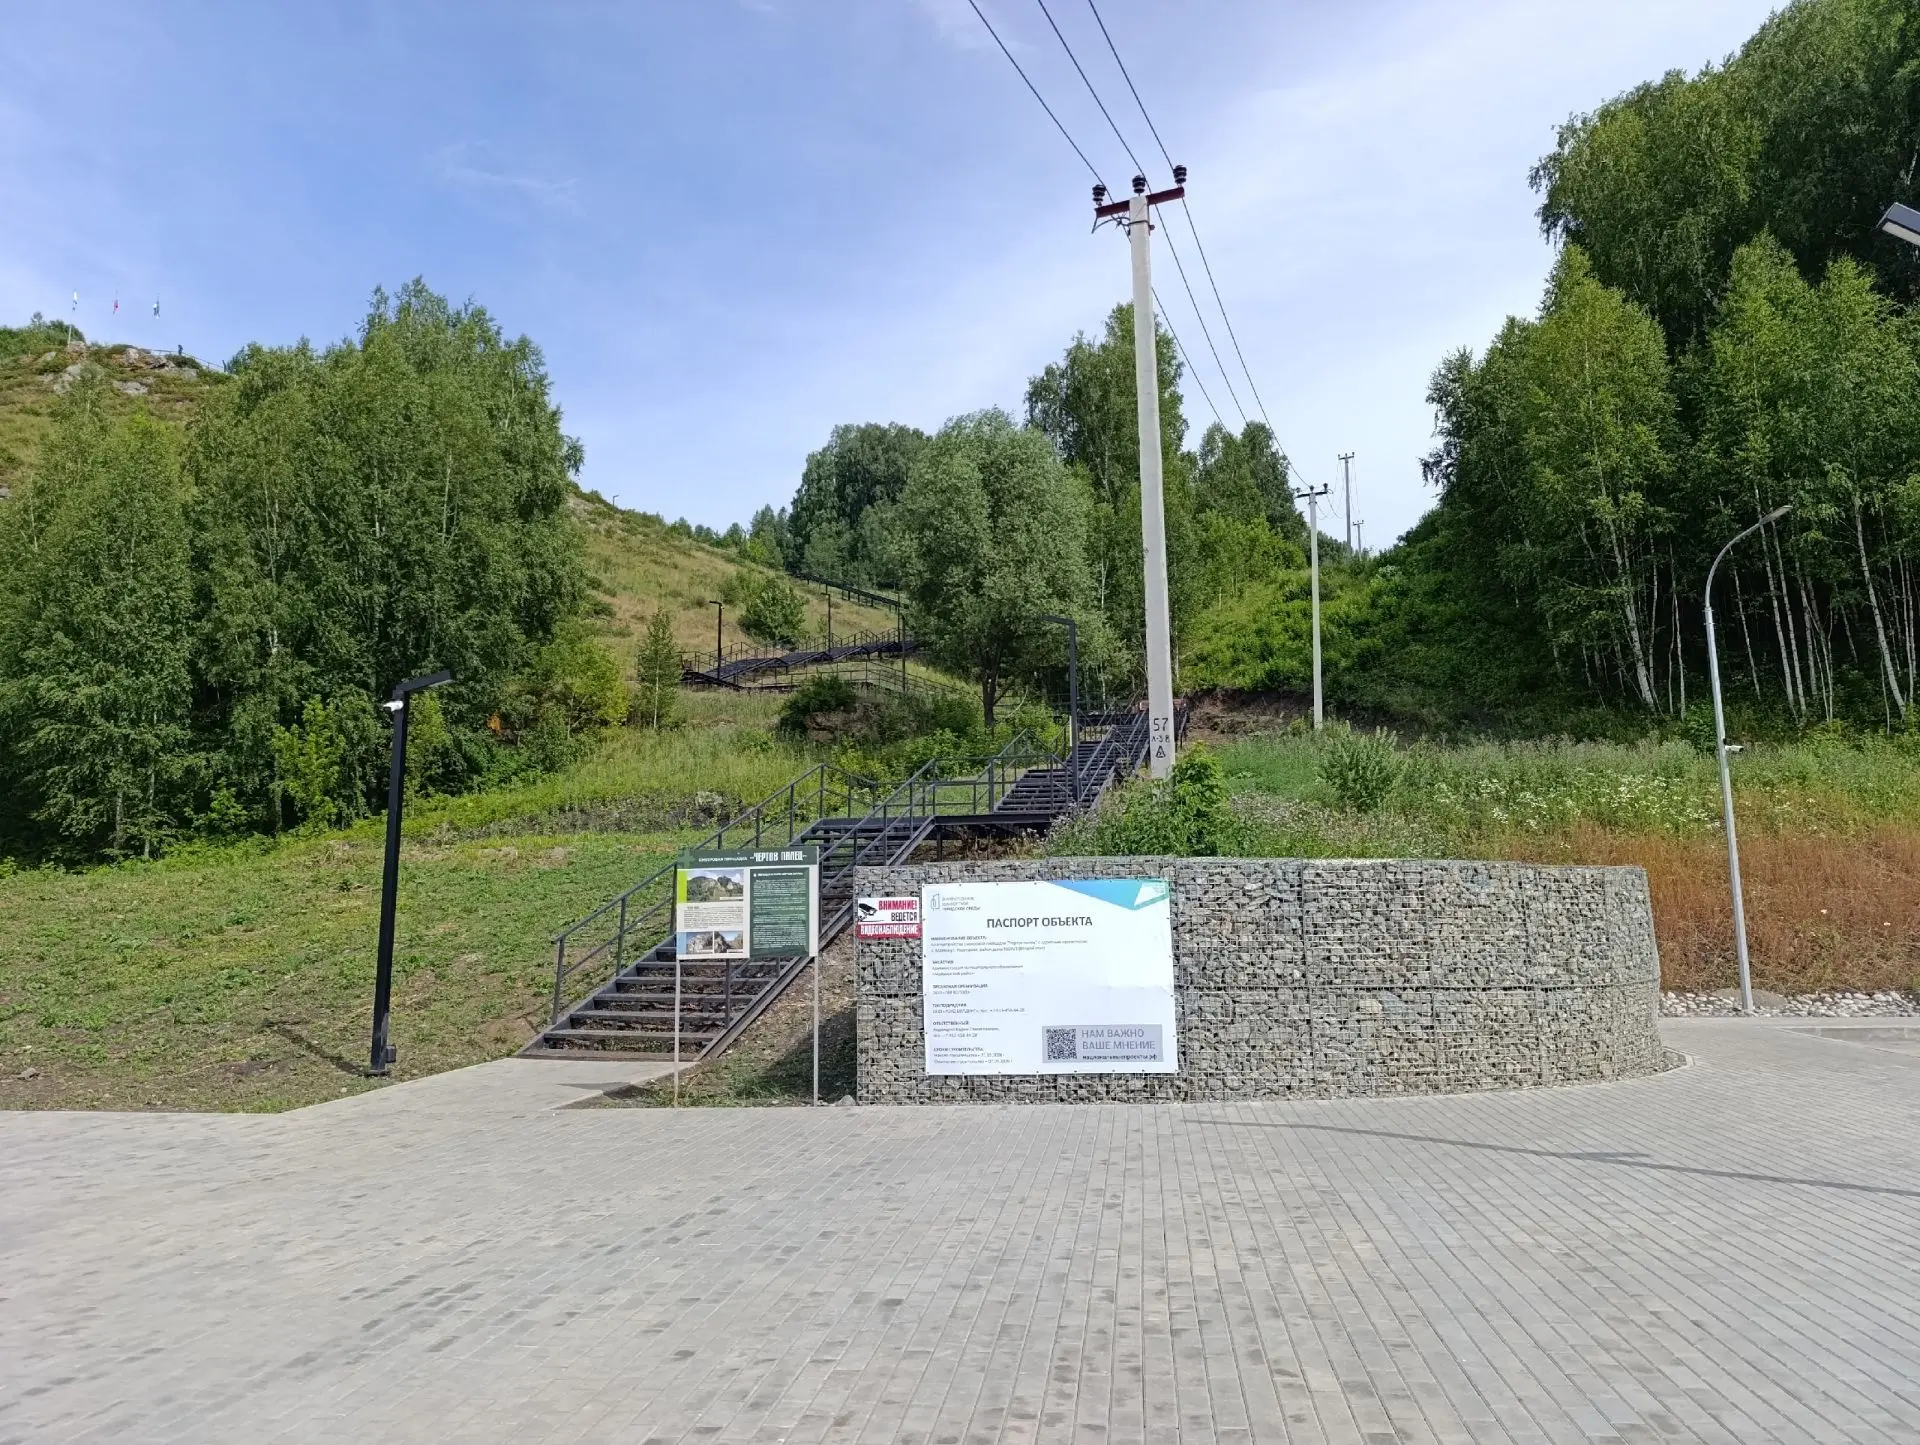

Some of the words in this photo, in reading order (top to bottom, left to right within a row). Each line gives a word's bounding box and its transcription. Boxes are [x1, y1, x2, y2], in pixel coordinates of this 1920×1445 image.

[1153, 717, 1169, 731] 57
[878, 900, 918, 910] ВНИМАНИЕ!
[891, 911, 918, 922] ВЕДЕТСЯ
[986, 917, 1040, 929] ПАСПОРТ
[1041, 916, 1093, 927] ОБЪЕКТА
[860, 924, 919, 936] ВИДЕОНАБЛЮДЕНИЕ
[1081, 1029, 1105, 1038] НАМ
[1107, 1028, 1145, 1038] ВАЖНО
[1082, 1041, 1112, 1050] ВАШЕ
[1113, 1041, 1156, 1050] МНЕНИЕ
